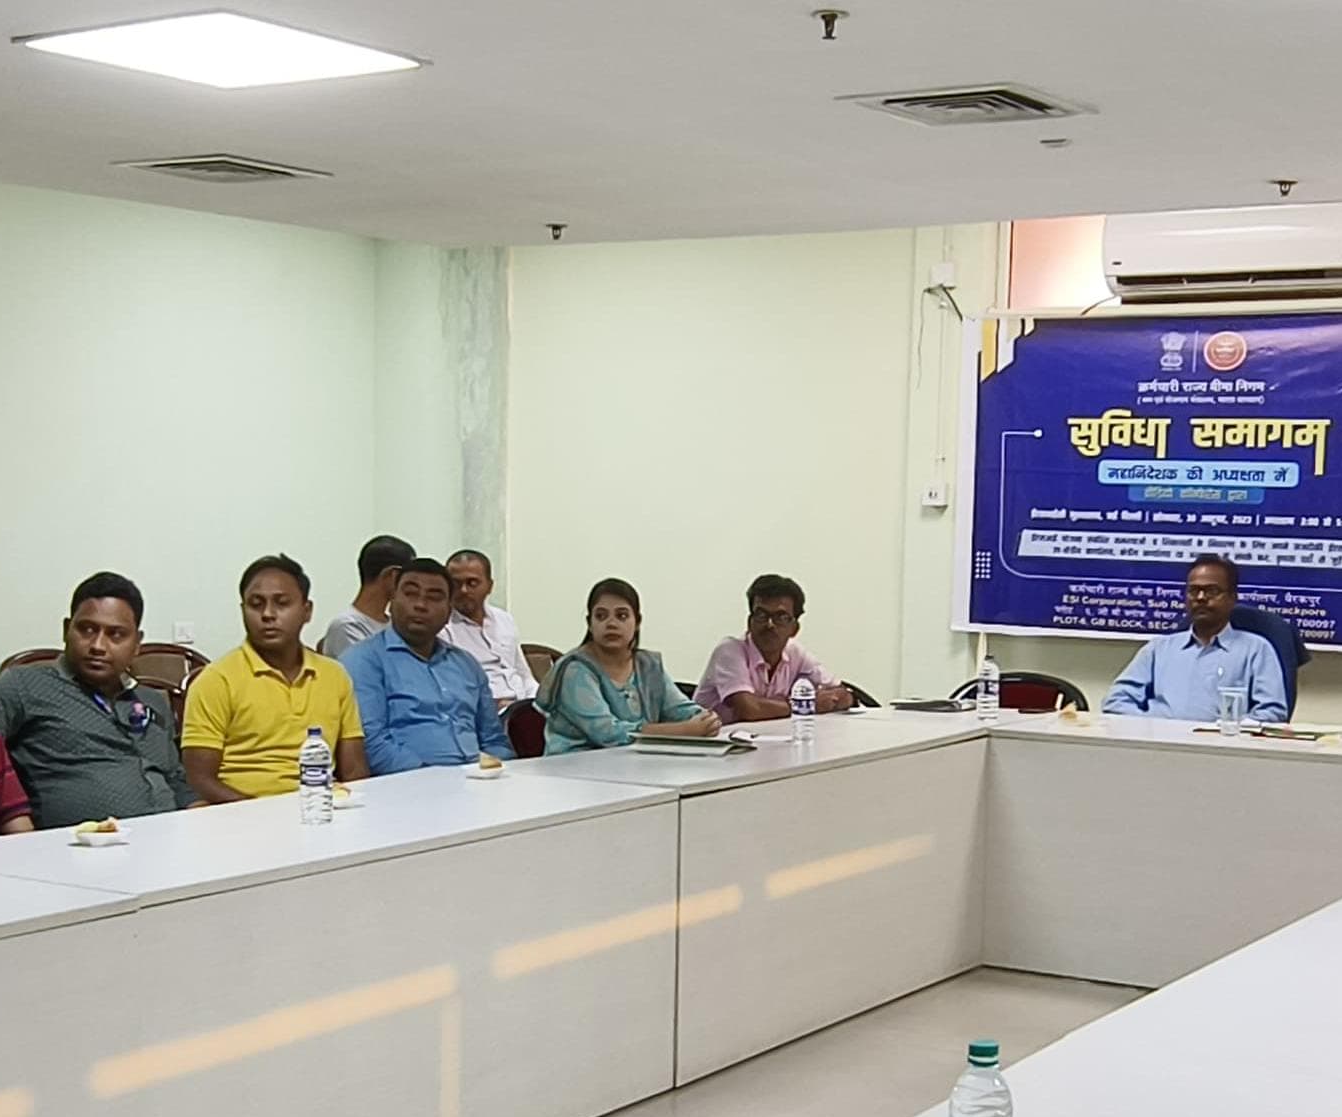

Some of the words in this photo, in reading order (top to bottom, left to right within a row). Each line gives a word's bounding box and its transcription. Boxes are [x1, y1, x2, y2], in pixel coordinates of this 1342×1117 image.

[1236, 378, 1265, 392] निगम
[1067, 408, 1172, 459] सुविधा
[1190, 418, 1331, 476] समागम
[1108, 464, 1178, 480] महानिदेशक
[1185, 465, 1203, 481] की
[1212, 467, 1266, 482] अध्यक्षता
[1273, 466, 1290, 483] में
[1062, 594, 1080, 604] ESI
[1147, 599, 1169, 609] Sub
[1090, 617, 1107, 627] GB
[1296, 618, 1336, 630] 700097
